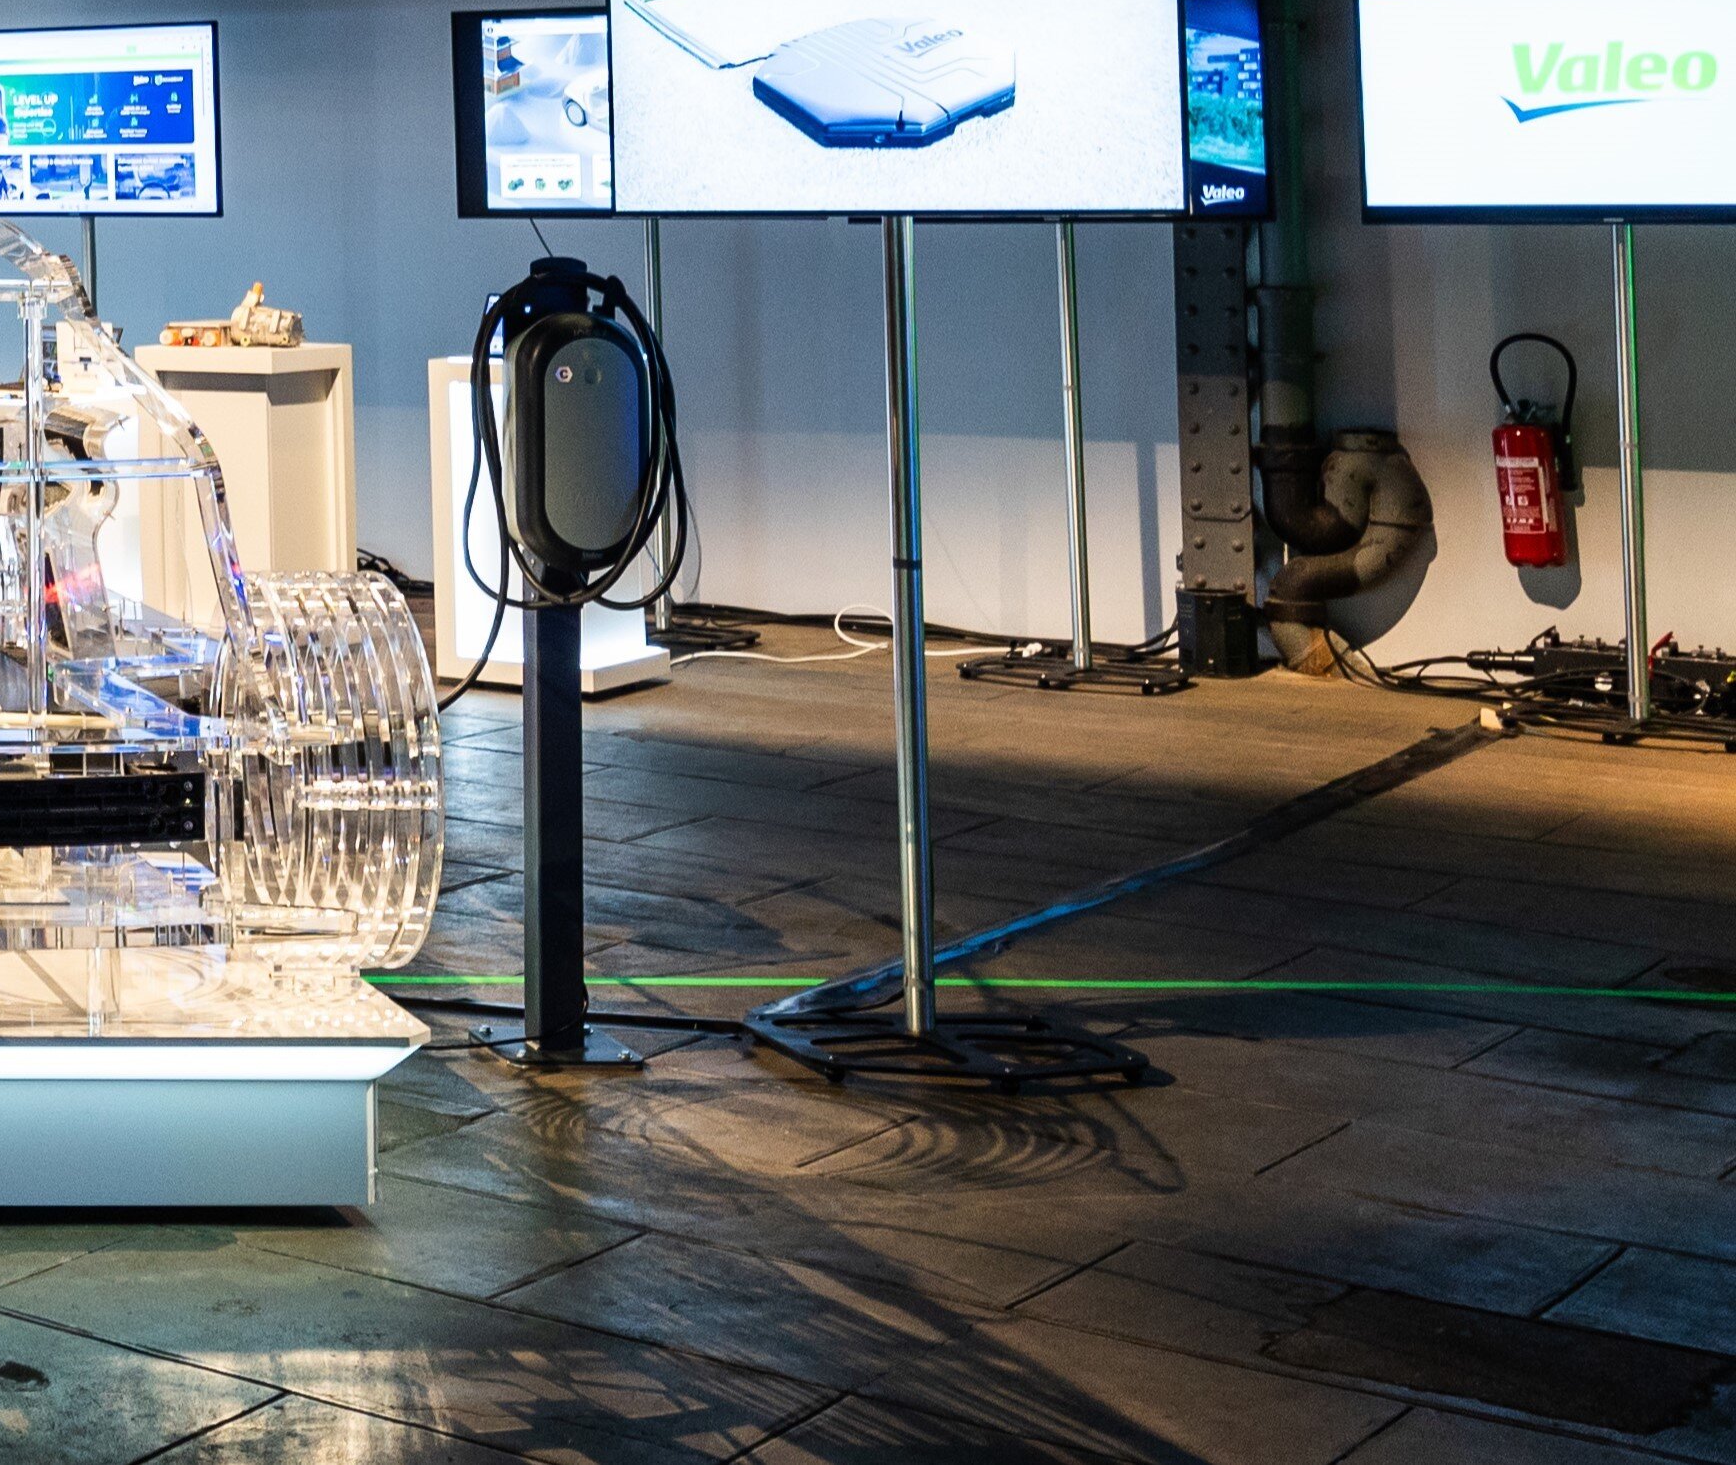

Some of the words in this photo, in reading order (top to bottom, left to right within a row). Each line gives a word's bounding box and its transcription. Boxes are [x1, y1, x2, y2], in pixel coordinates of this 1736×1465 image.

[894, 28, 964, 54] Valeo
[1511, 39, 1719, 94] Valeo
[1202, 184, 1245, 199] Valeo
